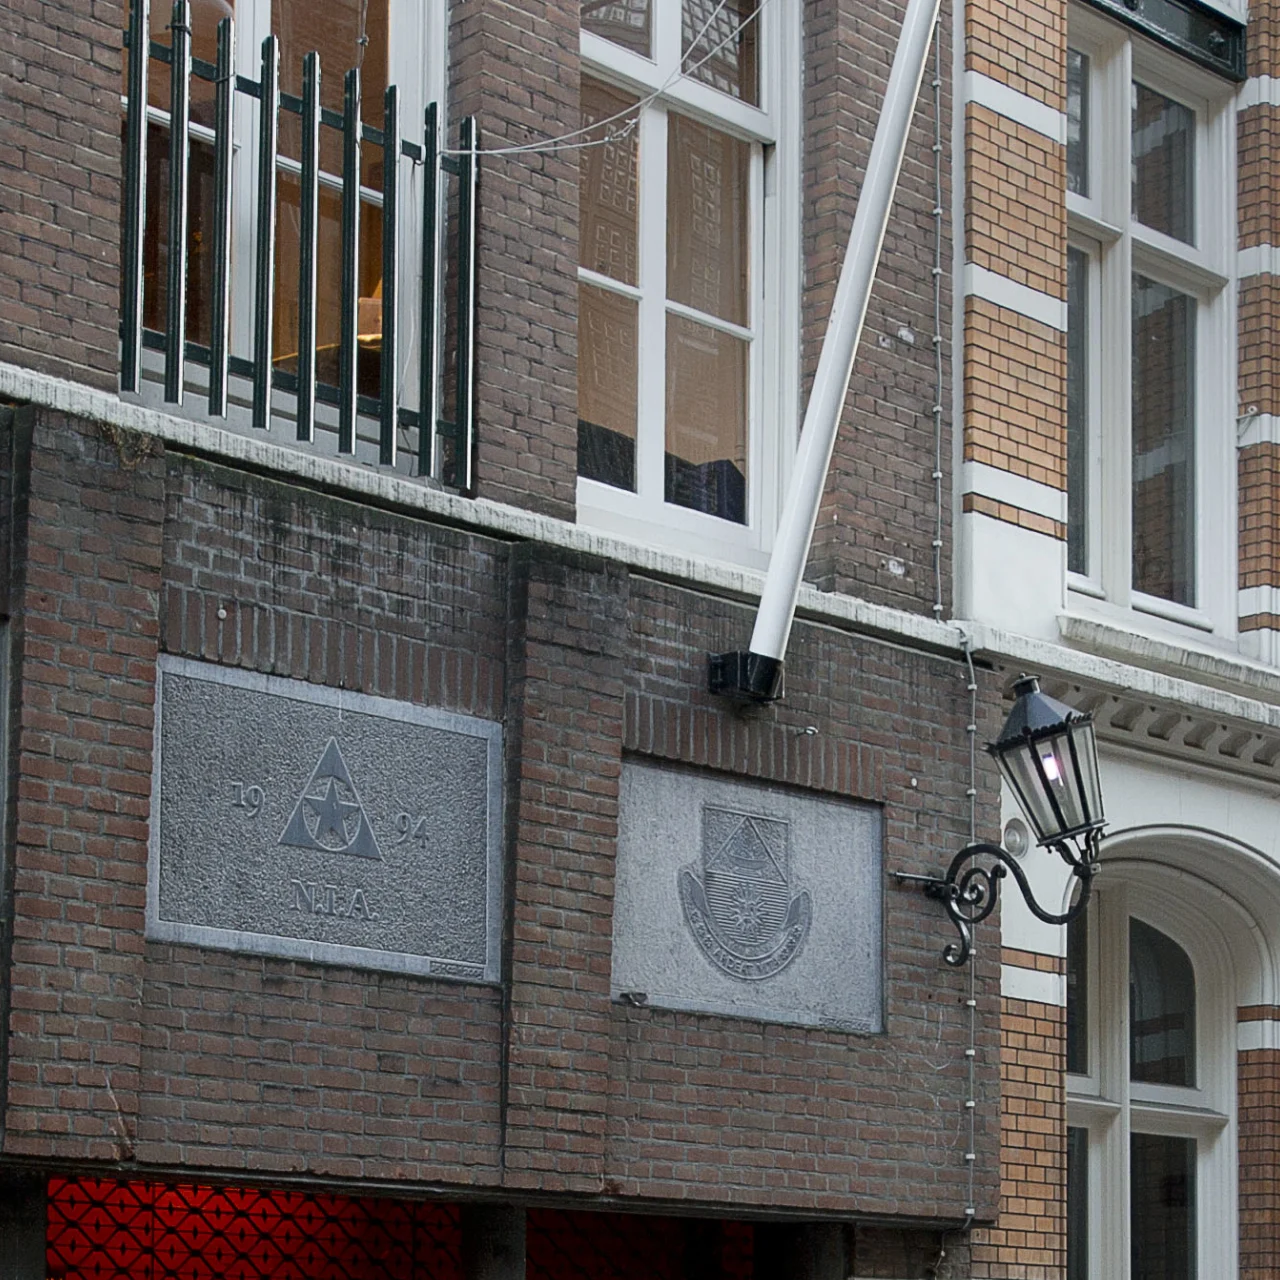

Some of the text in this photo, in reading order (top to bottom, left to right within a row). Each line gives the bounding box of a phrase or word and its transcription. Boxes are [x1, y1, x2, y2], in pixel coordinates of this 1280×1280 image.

[230, 782, 429, 849] 19 94
[290, 878, 380, 919] N.I.A.
